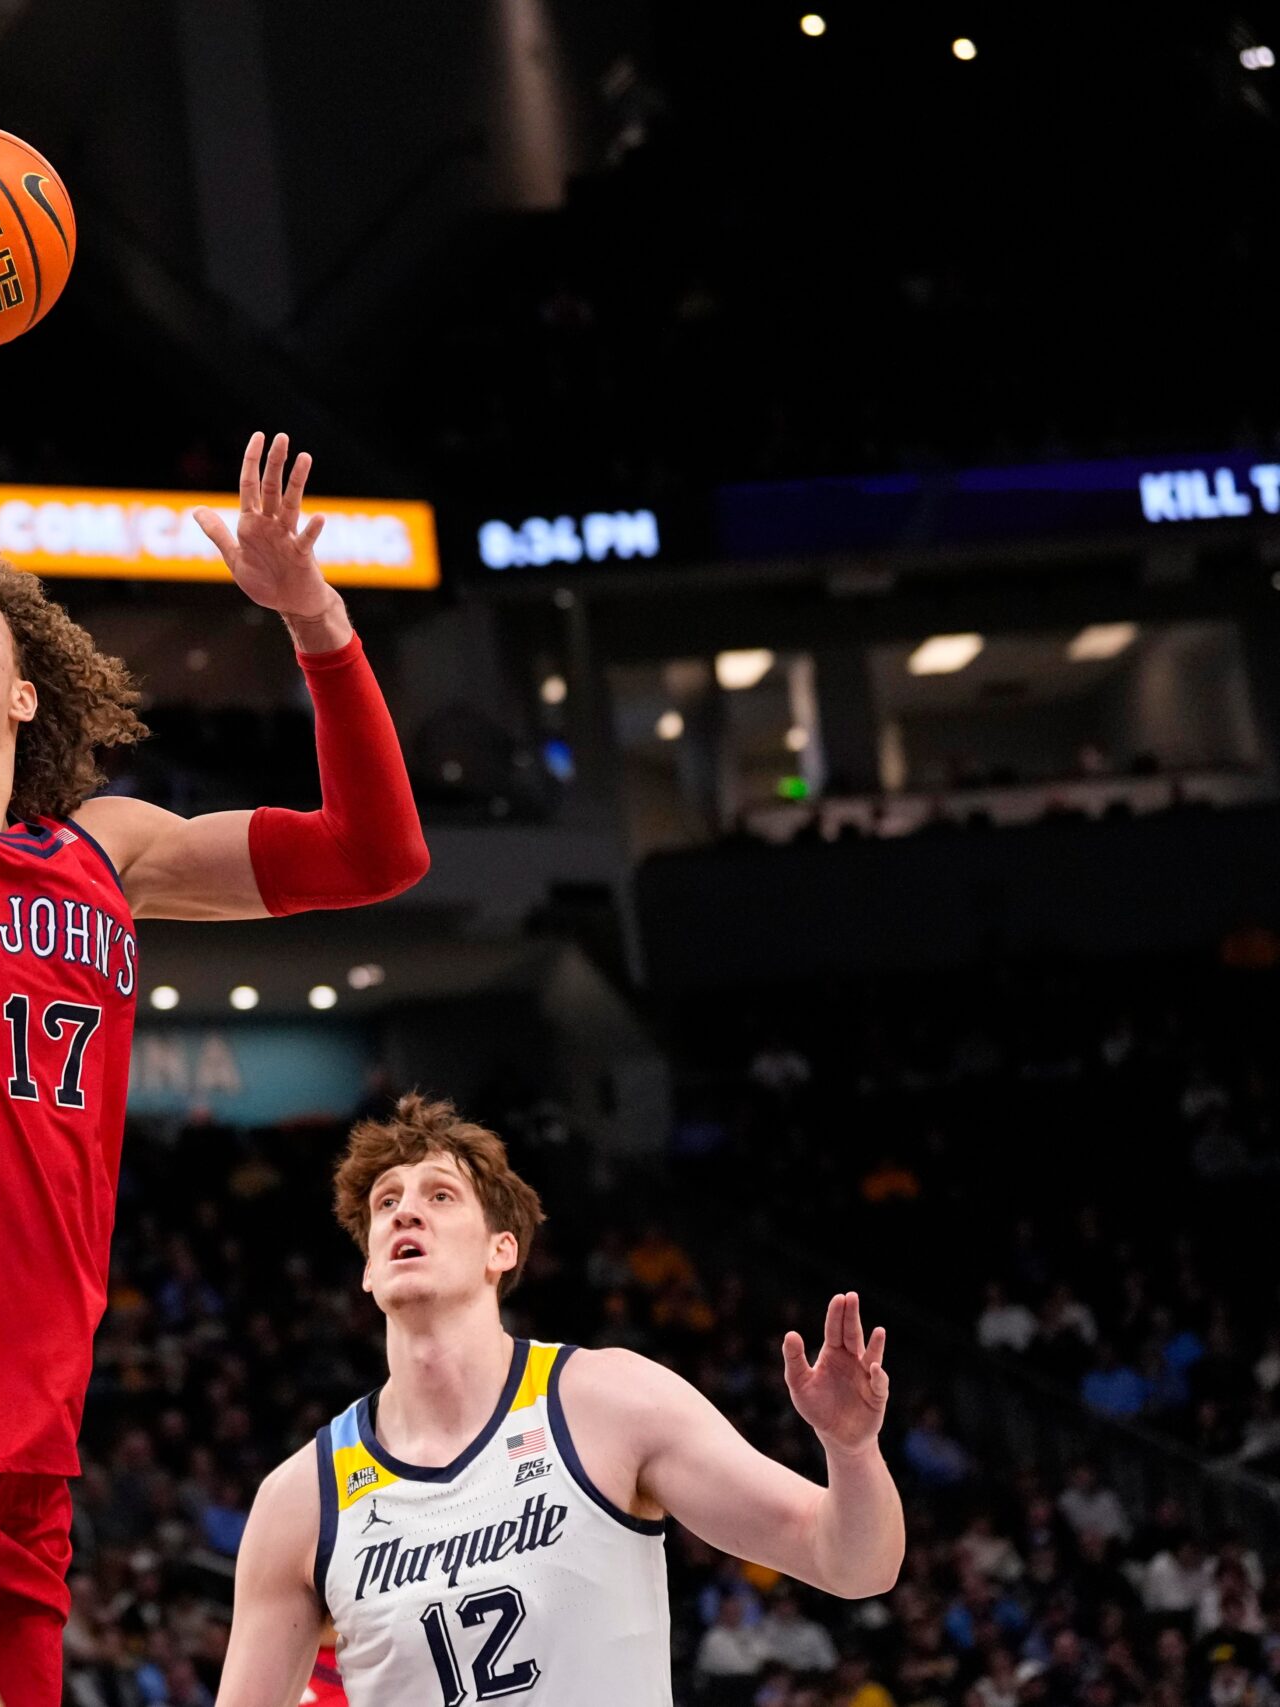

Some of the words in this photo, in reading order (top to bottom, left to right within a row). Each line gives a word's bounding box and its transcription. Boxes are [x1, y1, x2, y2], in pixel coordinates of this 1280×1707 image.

[1139, 466, 1252, 523] KILL
[582, 508, 660, 562] PM
[3, 993, 102, 1110] 17
[356, 1466, 375, 1479] THE
[515, 1463, 552, 1482] EAST
[518, 1457, 544, 1473] BIG
[355, 1492, 568, 1601] Marquette
[420, 1585, 541, 1707] 12
